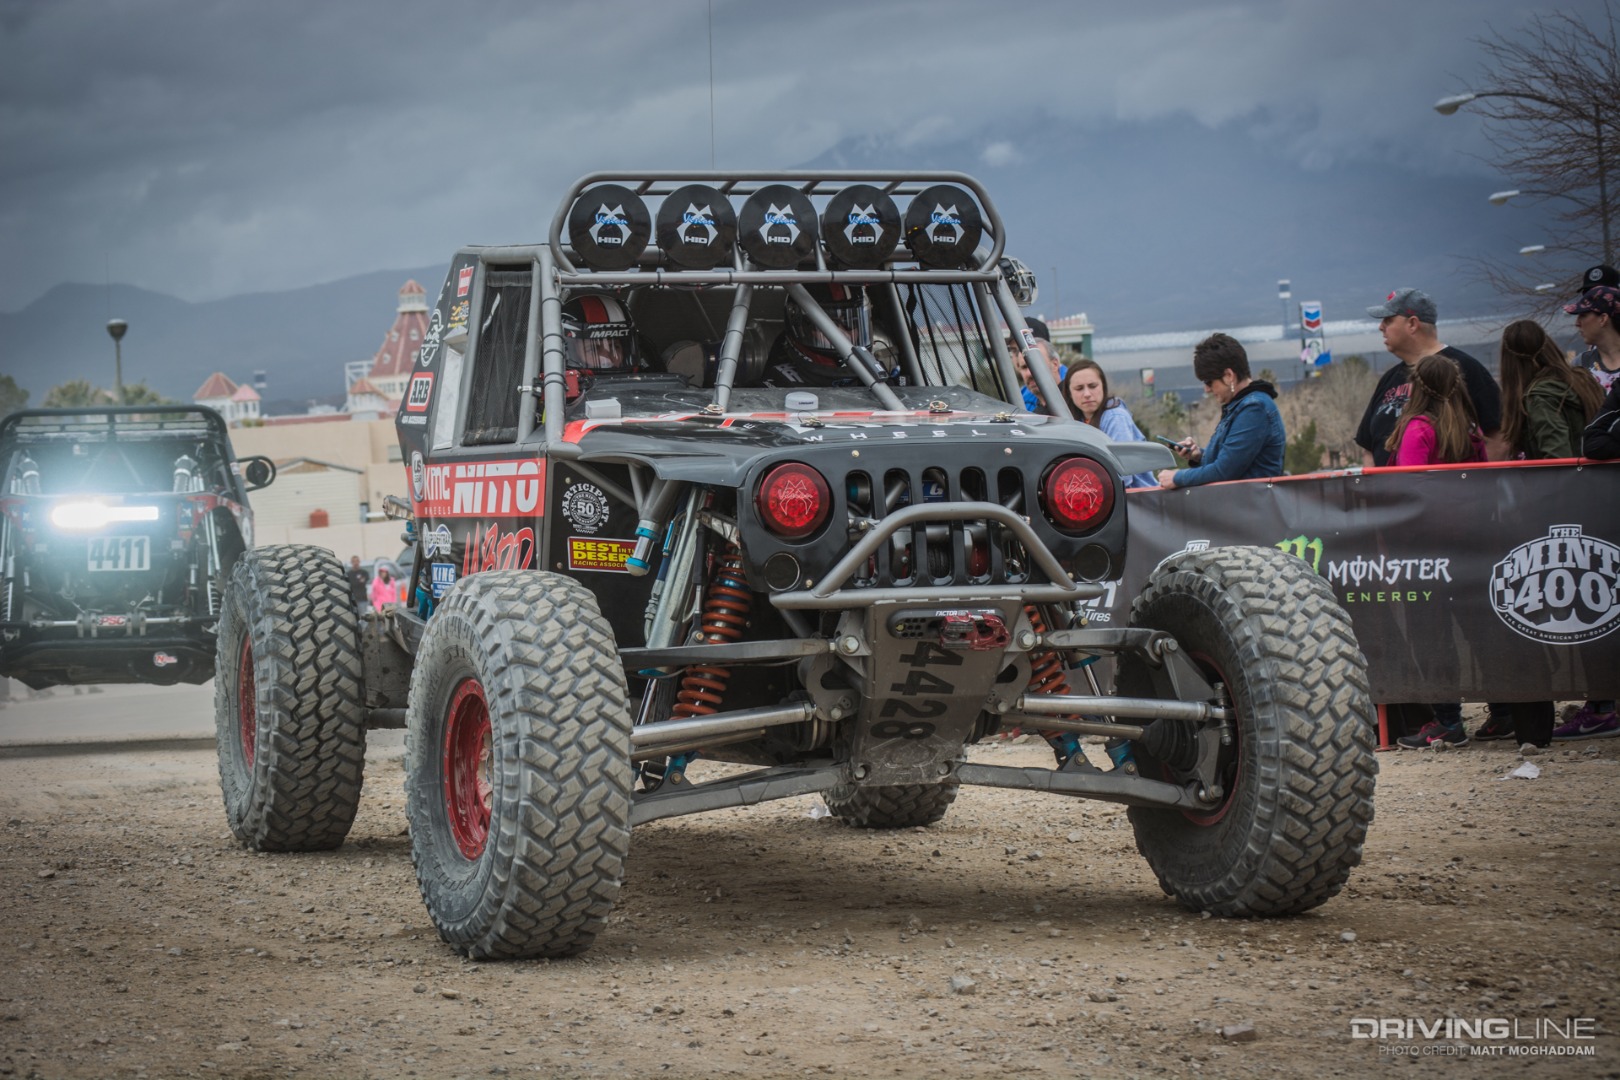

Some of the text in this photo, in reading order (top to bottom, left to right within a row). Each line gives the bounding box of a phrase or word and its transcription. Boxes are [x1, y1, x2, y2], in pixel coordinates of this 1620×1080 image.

[595, 213, 628, 225] Vision
[683, 213, 715, 225] Vision
[765, 213, 797, 224] Vision
[848, 213, 880, 224] Vision
[931, 213, 960, 224] Vision
[598, 236, 621, 244] HID
[685, 235, 708, 244] HID
[768, 235, 791, 243] HID
[852, 235, 875, 243] HID
[933, 235, 955, 243] HID
[590, 329, 630, 338] IMPACT
[410, 380, 430, 403] ARB
[414, 460, 422, 473] US
[453, 461, 540, 514] NITTO
[562, 483, 610, 523] PARTICIPANT
[577, 501, 595, 516] 50
[424, 506, 451, 515] WHEELS
[1551, 528, 1580, 538] THE
[572, 541, 620, 553] BEST
[1187, 543, 1208, 551] THE
[90, 538, 147, 569] 4411
[573, 551, 632, 562] DESER
[1509, 537, 1620, 583] MINT
[432, 566, 455, 583] KING
[1346, 591, 1432, 602] ENERGY
[1514, 568, 1613, 614] 400
[98, 615, 126, 625] PSC
[870, 641, 964, 740] 4428
